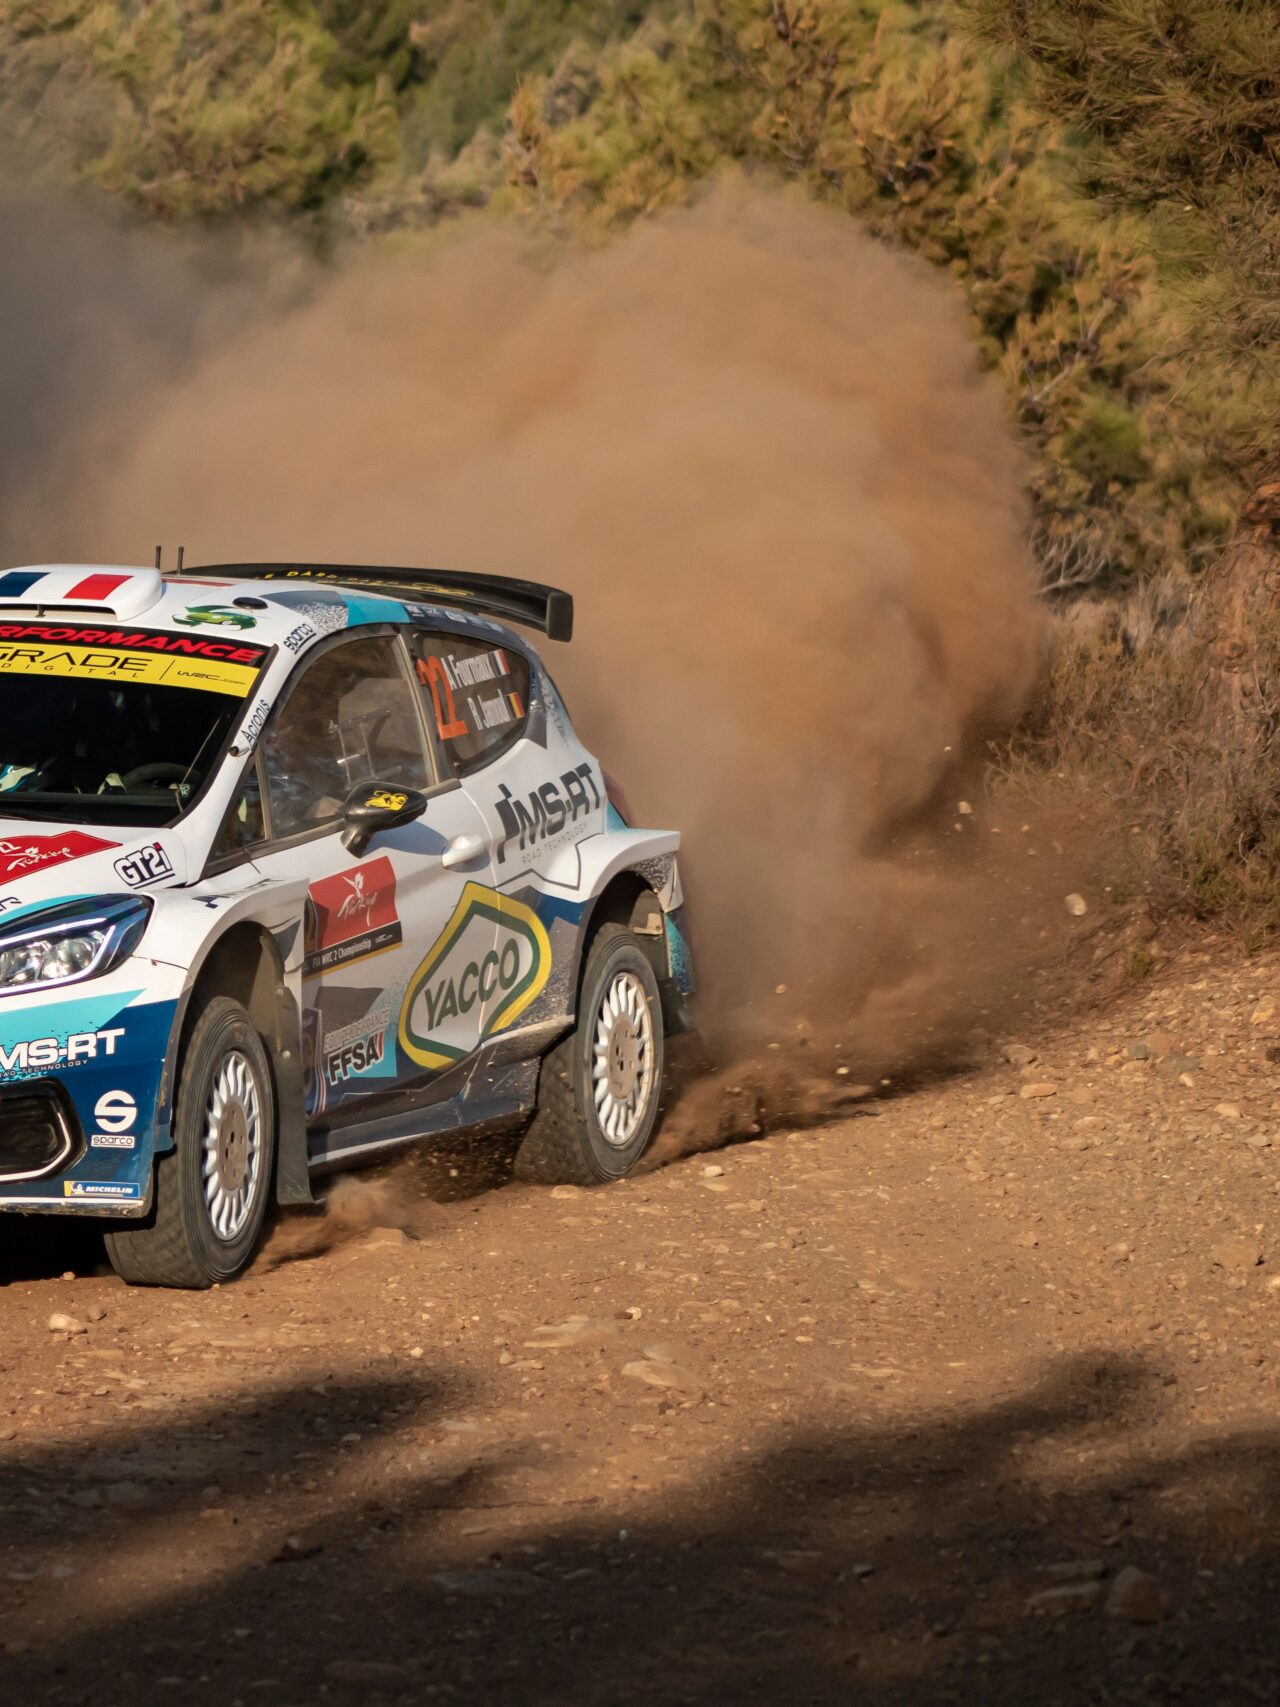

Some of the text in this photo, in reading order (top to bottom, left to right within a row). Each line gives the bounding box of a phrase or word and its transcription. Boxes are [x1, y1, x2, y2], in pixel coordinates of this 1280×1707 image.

[283, 622, 315, 653] sparco
[1, 662, 138, 679] DIGITAL
[440, 657, 457, 691] A
[240, 699, 271, 747] Acronis
[424, 938, 520, 1032] YACCO
[22, 1059, 88, 1074] TECHNOLOGY
[328, 1032, 381, 1084] FFSA
[93, 1136, 133, 1147] sparco
[85, 1185, 134, 1194] MICHELIN
